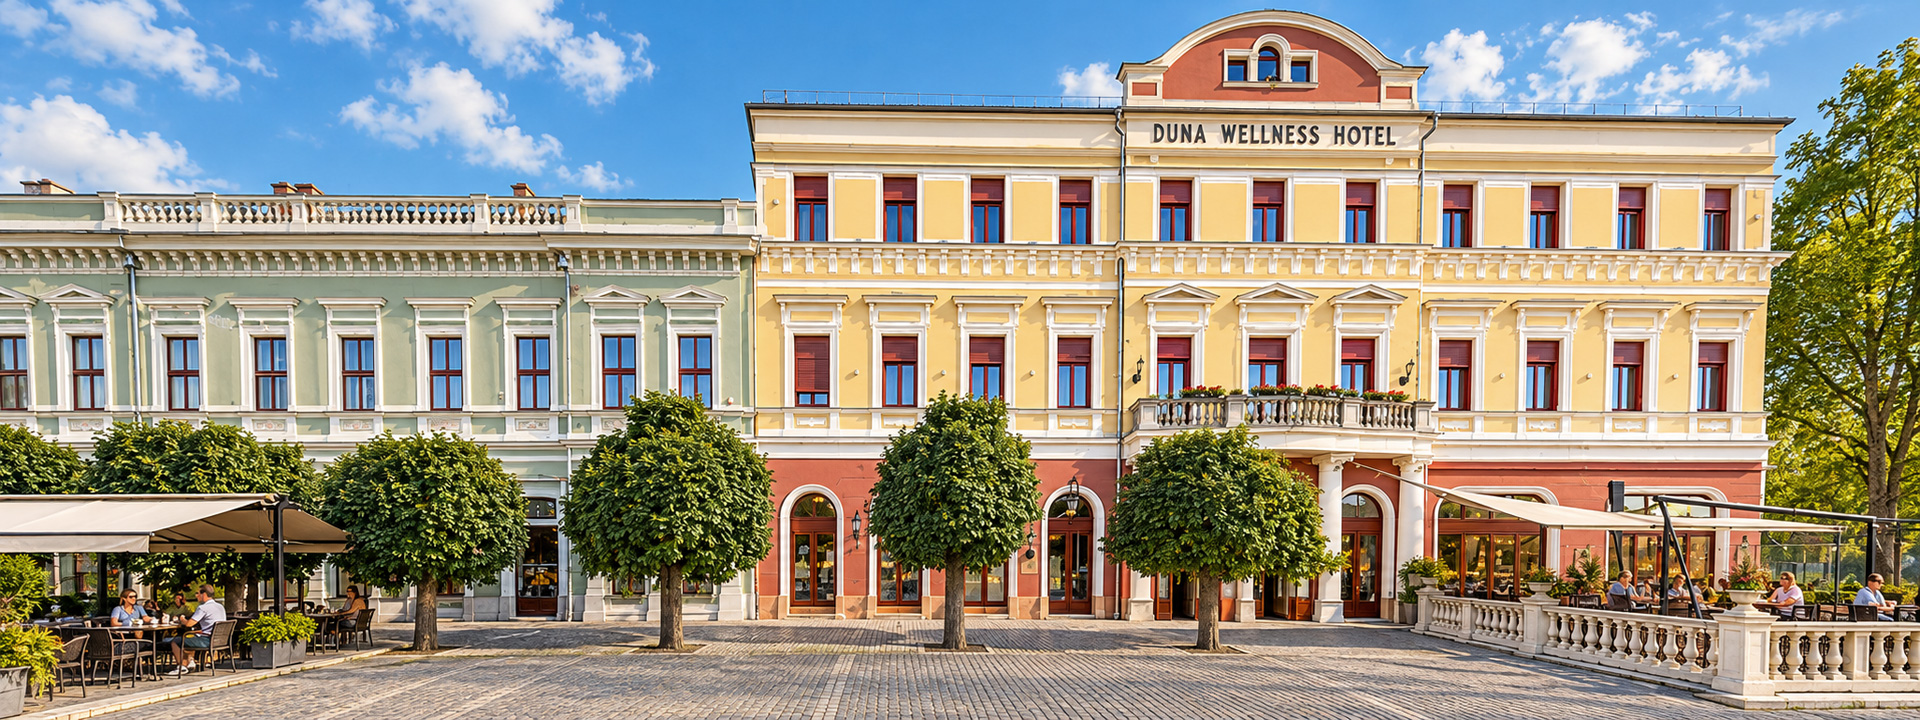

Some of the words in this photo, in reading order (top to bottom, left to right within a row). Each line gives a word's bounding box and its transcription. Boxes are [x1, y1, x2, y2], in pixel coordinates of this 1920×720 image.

[1153, 123, 1206, 143] DUNA
[1221, 123, 1319, 144] WELLNESS
[1334, 125, 1396, 145] HOTEL
